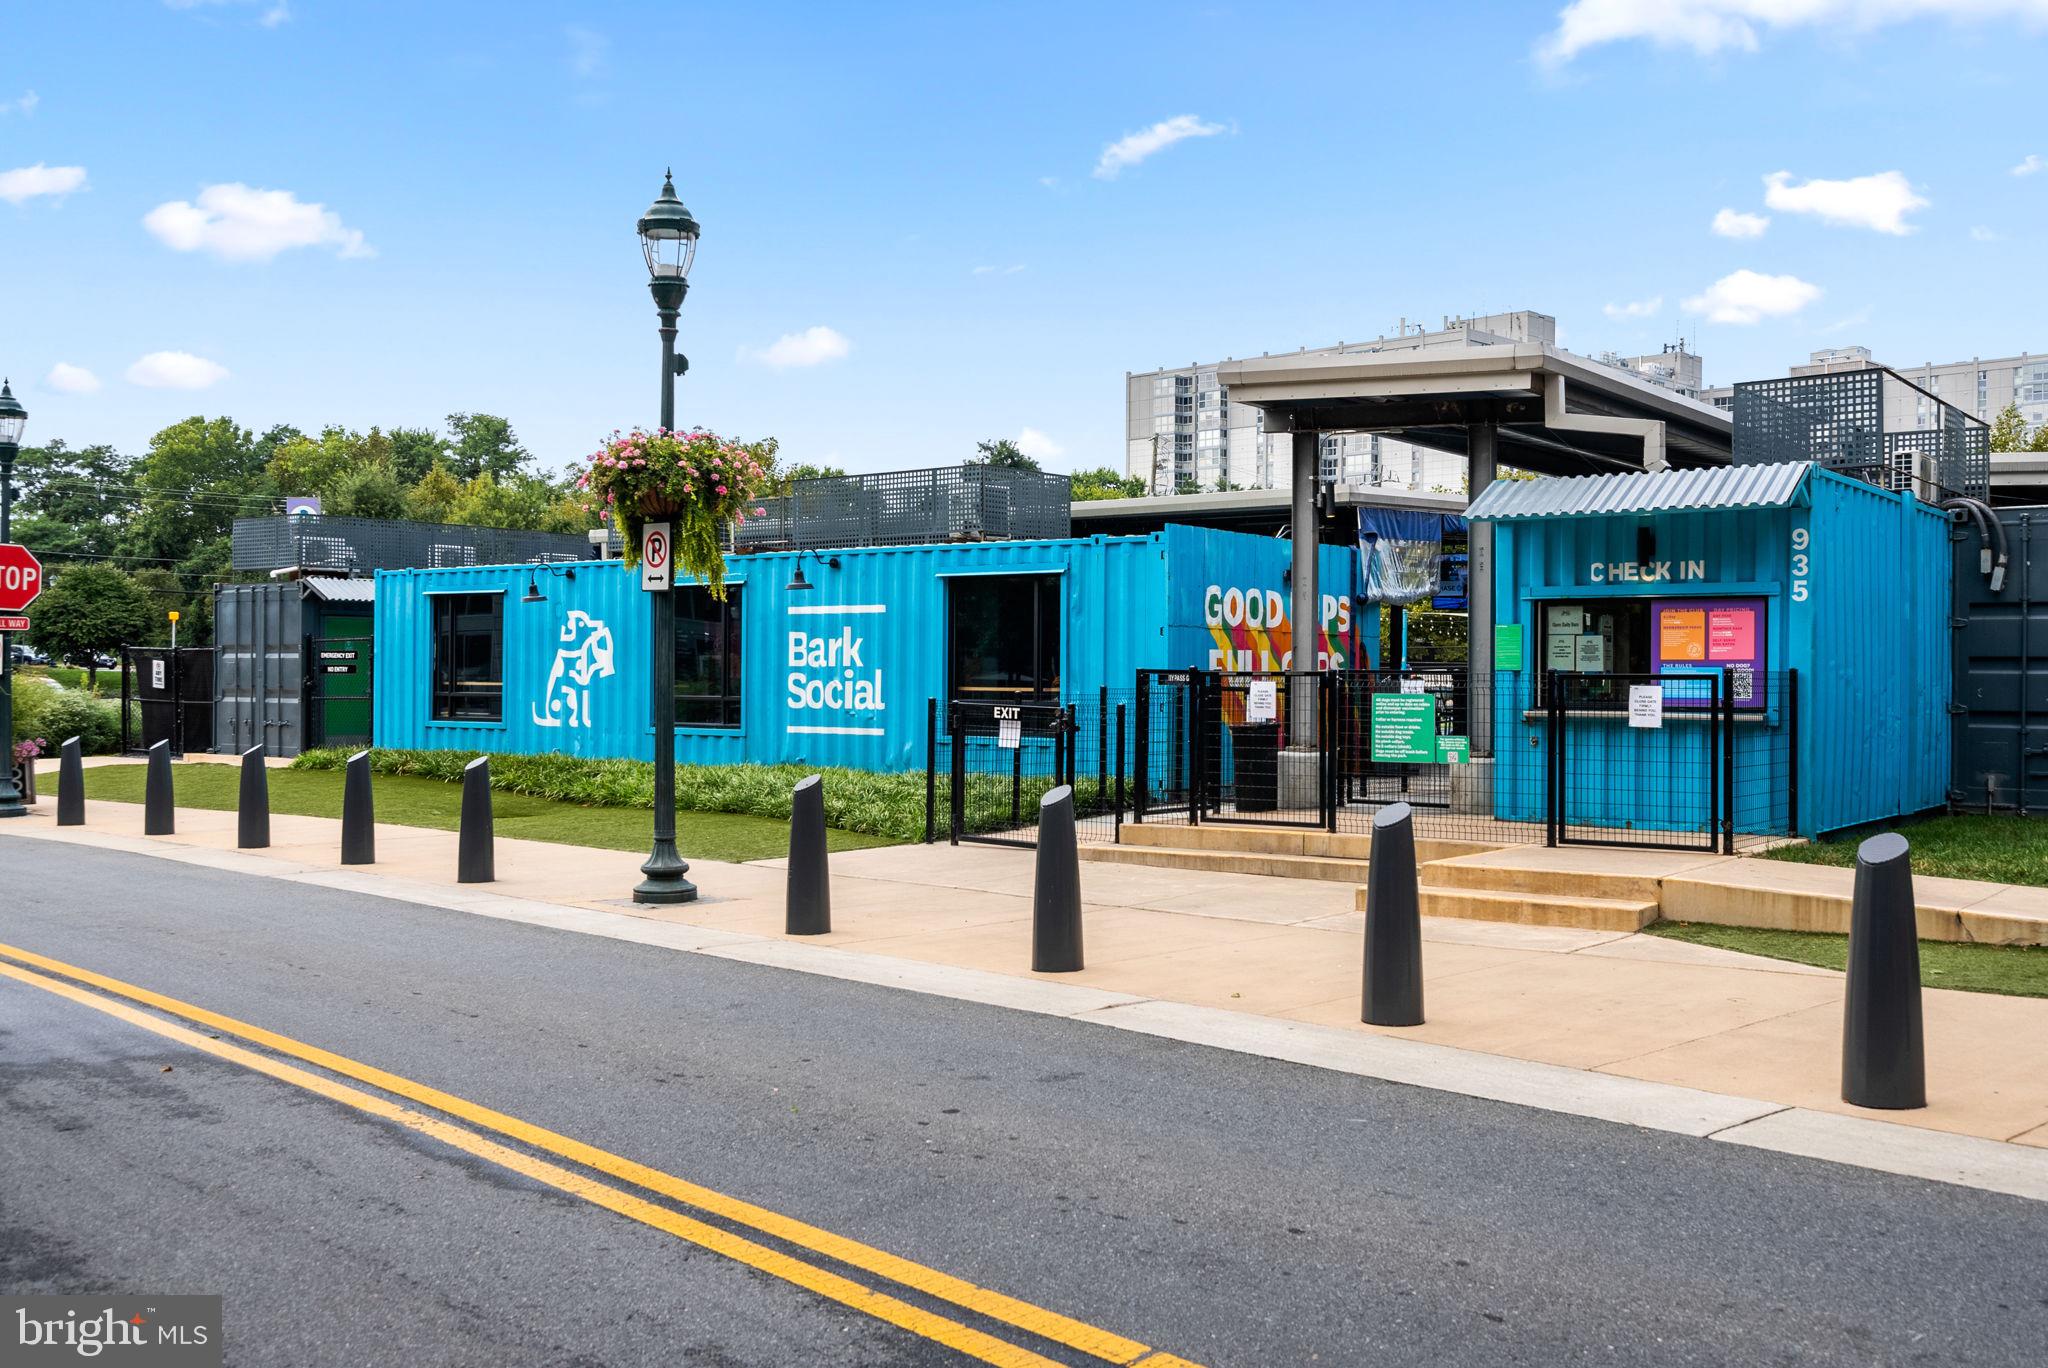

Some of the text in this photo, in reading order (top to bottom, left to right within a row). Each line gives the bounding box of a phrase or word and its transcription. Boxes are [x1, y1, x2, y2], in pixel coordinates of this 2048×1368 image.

[1590, 560, 1705, 582] CHECK IN
[1205, 584, 1284, 629] GOOD
[8, 619, 26, 628] WAY
[788, 626, 863, 668] Bark
[787, 669, 885, 710] Social
[994, 706, 1020, 719] EXIT
